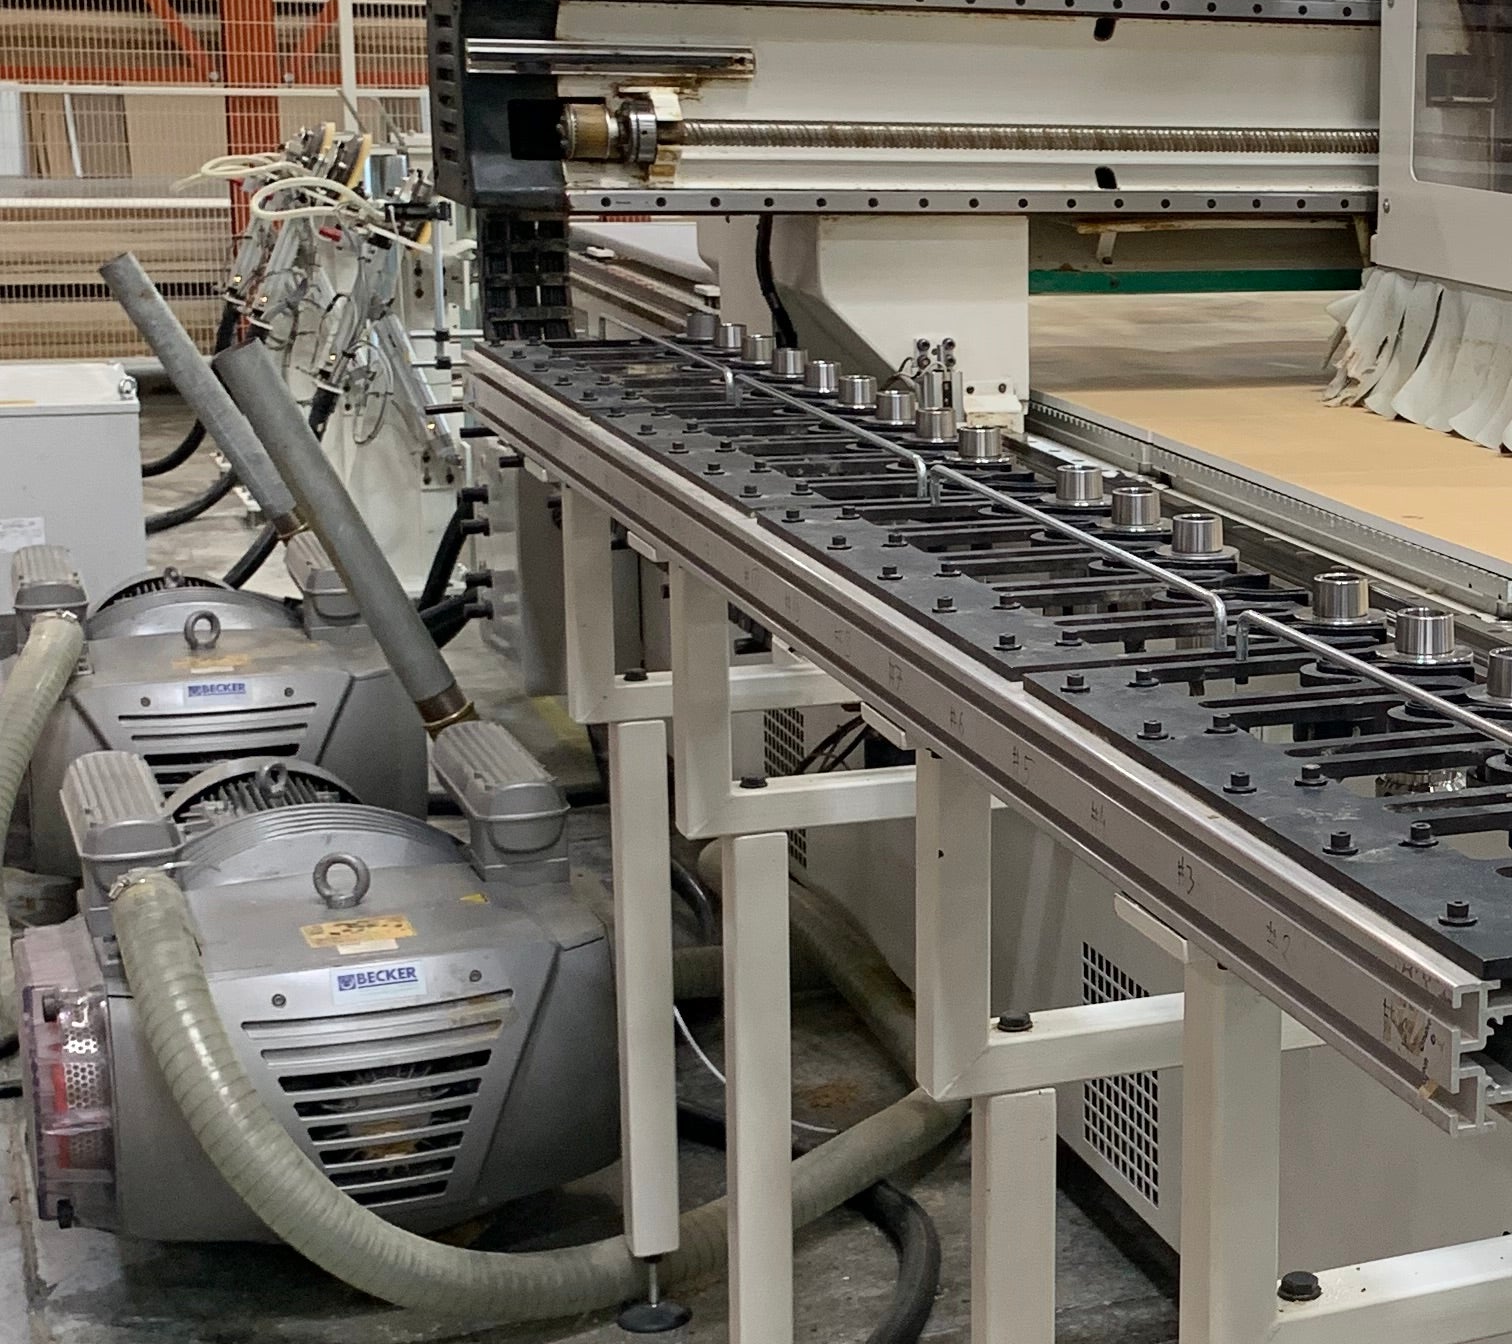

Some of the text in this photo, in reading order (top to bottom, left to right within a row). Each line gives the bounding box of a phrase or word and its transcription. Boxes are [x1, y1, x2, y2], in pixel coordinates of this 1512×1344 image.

[201, 682, 246, 693] BECKER
[1177, 855, 1195, 895] #3
[356, 966, 416, 985] BECKER
